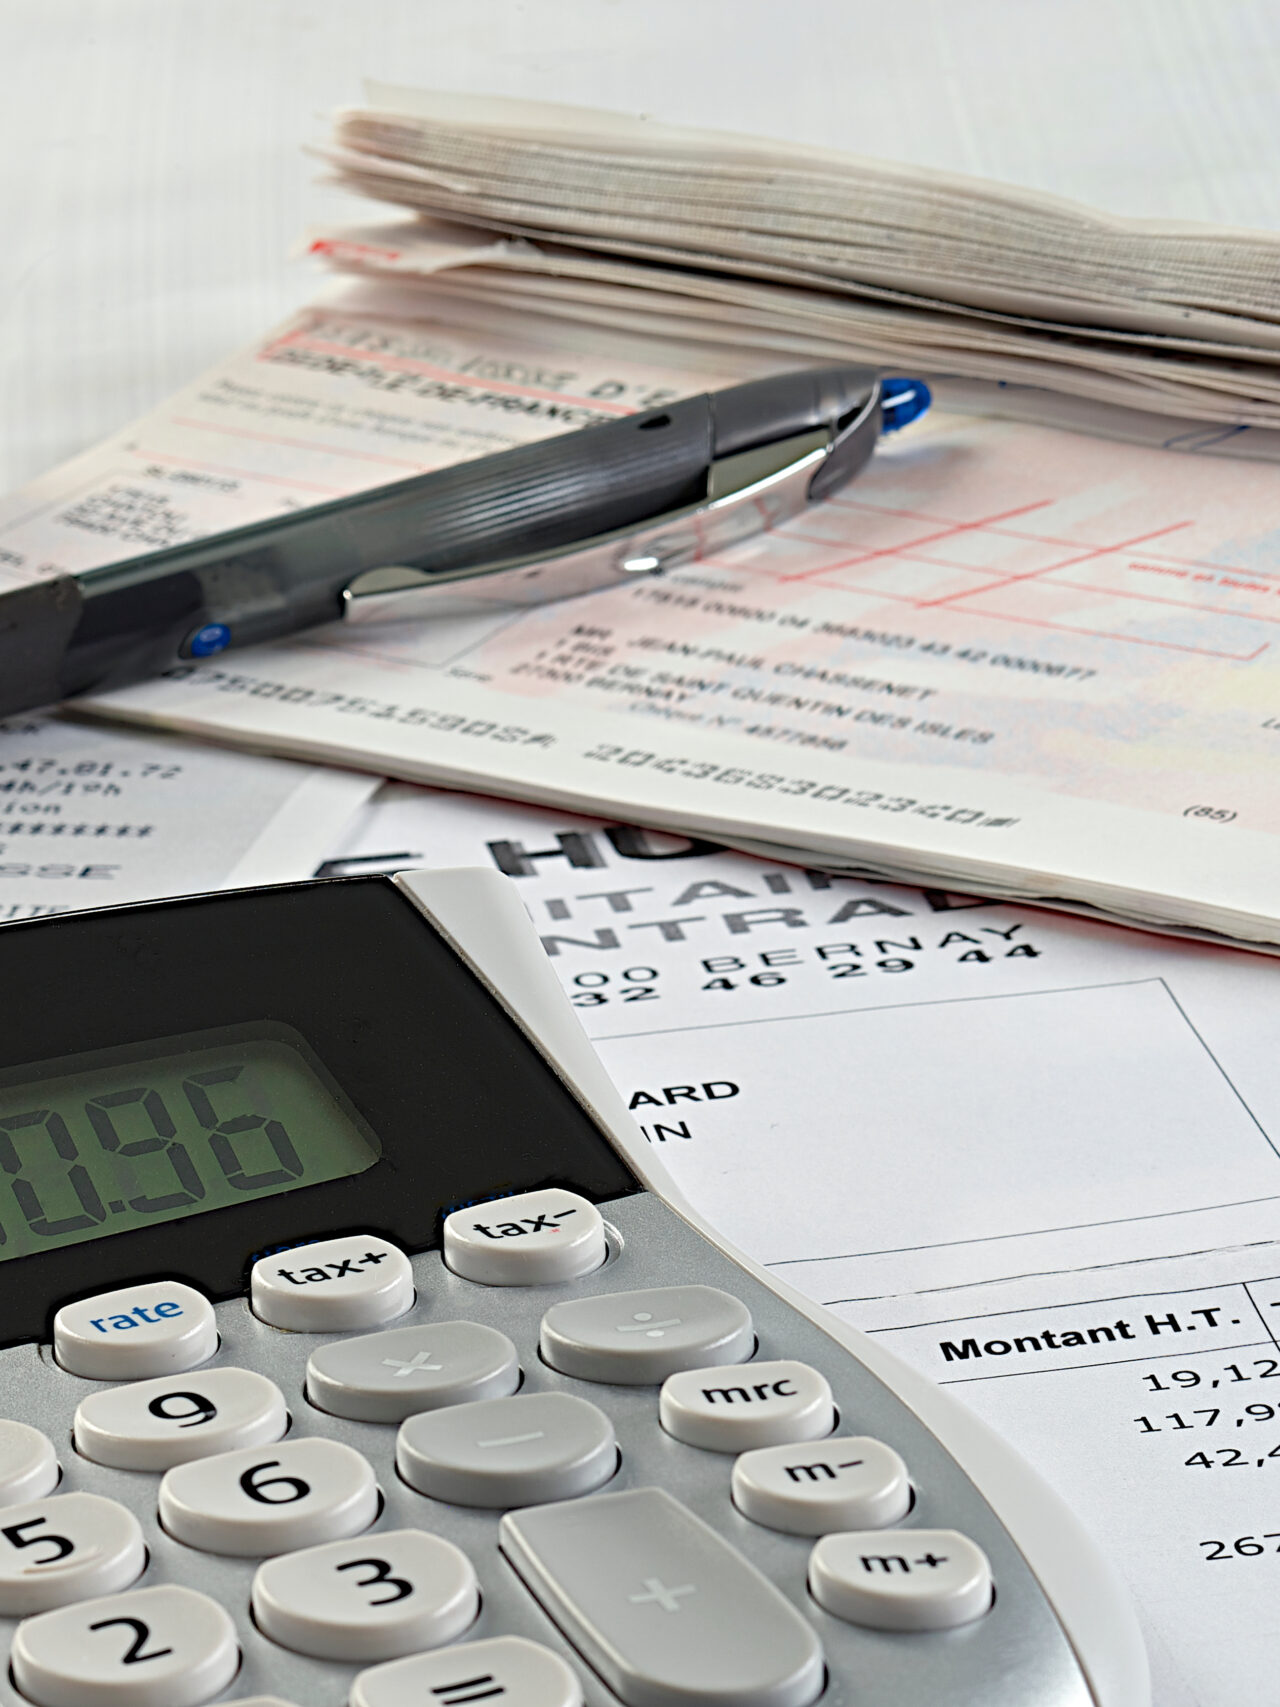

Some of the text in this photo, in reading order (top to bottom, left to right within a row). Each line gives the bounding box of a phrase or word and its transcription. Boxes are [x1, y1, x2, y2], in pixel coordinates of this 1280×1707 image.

[1183, 805, 1238, 824] (85)
[701, 924, 1027, 975] BERNAY
[568, 942, 1043, 1009] 32 46 29 44
[627, 1079, 741, 1111] ARD
[90, 1208, 577, 1333] rate tax+ tax-
[939, 1306, 1242, 1362] Montant H.T.
[1142, 1358, 1280, 1392] 19,12
[148, 1390, 218, 1428] 9
[1133, 1402, 1280, 1434] 117,9
[1, 1517, 75, 1565] 5
[239, 1460, 311, 1505] 6
[701, 1377, 800, 1404] mrc
[89, 1616, 173, 1665] 2
[335, 1557, 414, 1606] 3
[783, 1458, 865, 1484] m-
[858, 1551, 950, 1575] m+
